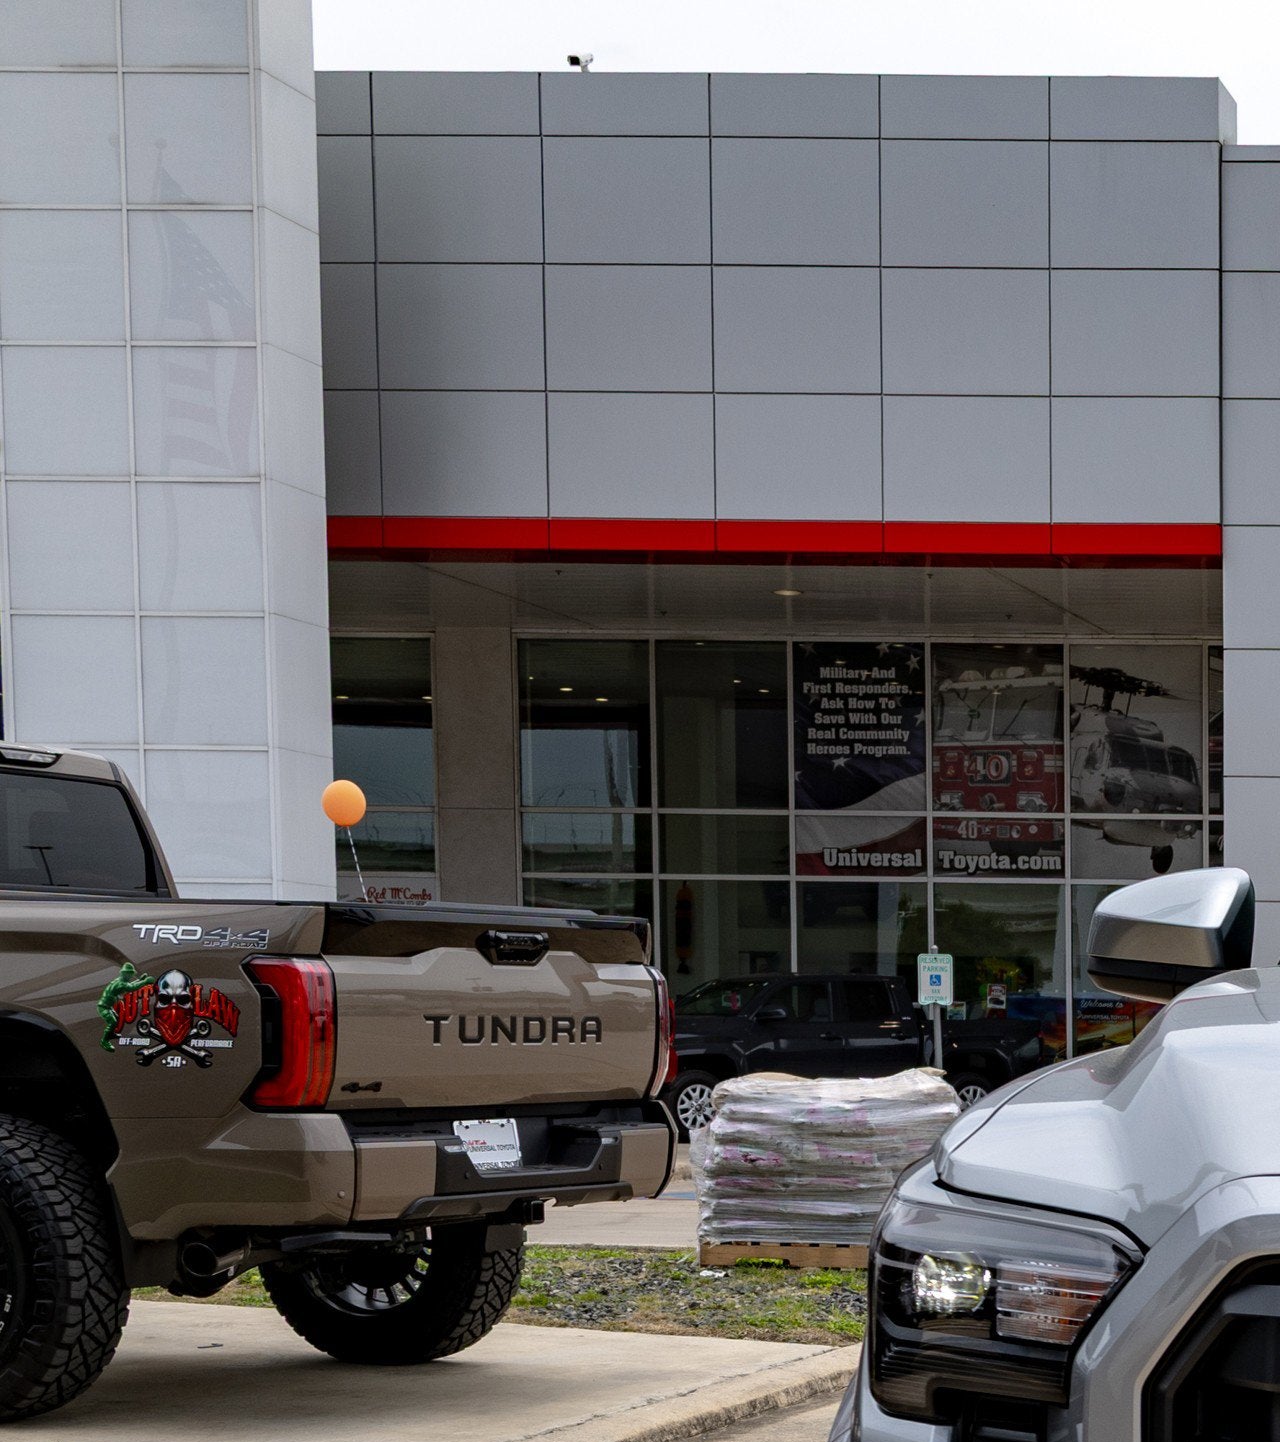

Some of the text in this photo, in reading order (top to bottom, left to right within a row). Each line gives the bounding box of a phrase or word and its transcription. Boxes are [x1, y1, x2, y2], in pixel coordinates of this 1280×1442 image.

[820, 667, 895, 680] Military And
[803, 682, 912, 696] First Responders,
[821, 698, 896, 709] Ask How To
[814, 713, 902, 724] Save With Our
[808, 728, 910, 742] Real Community
[807, 743, 911, 757] Heroes Program.
[957, 820, 979, 839] 40
[823, 848, 1062, 873] Universal Toyota.com
[367, 886, 432, 903] Red McCombs
[132, 924, 204, 944] TRD
[923, 965, 948, 973] PARKING
[423, 1014, 602, 1046] TUNDRA
